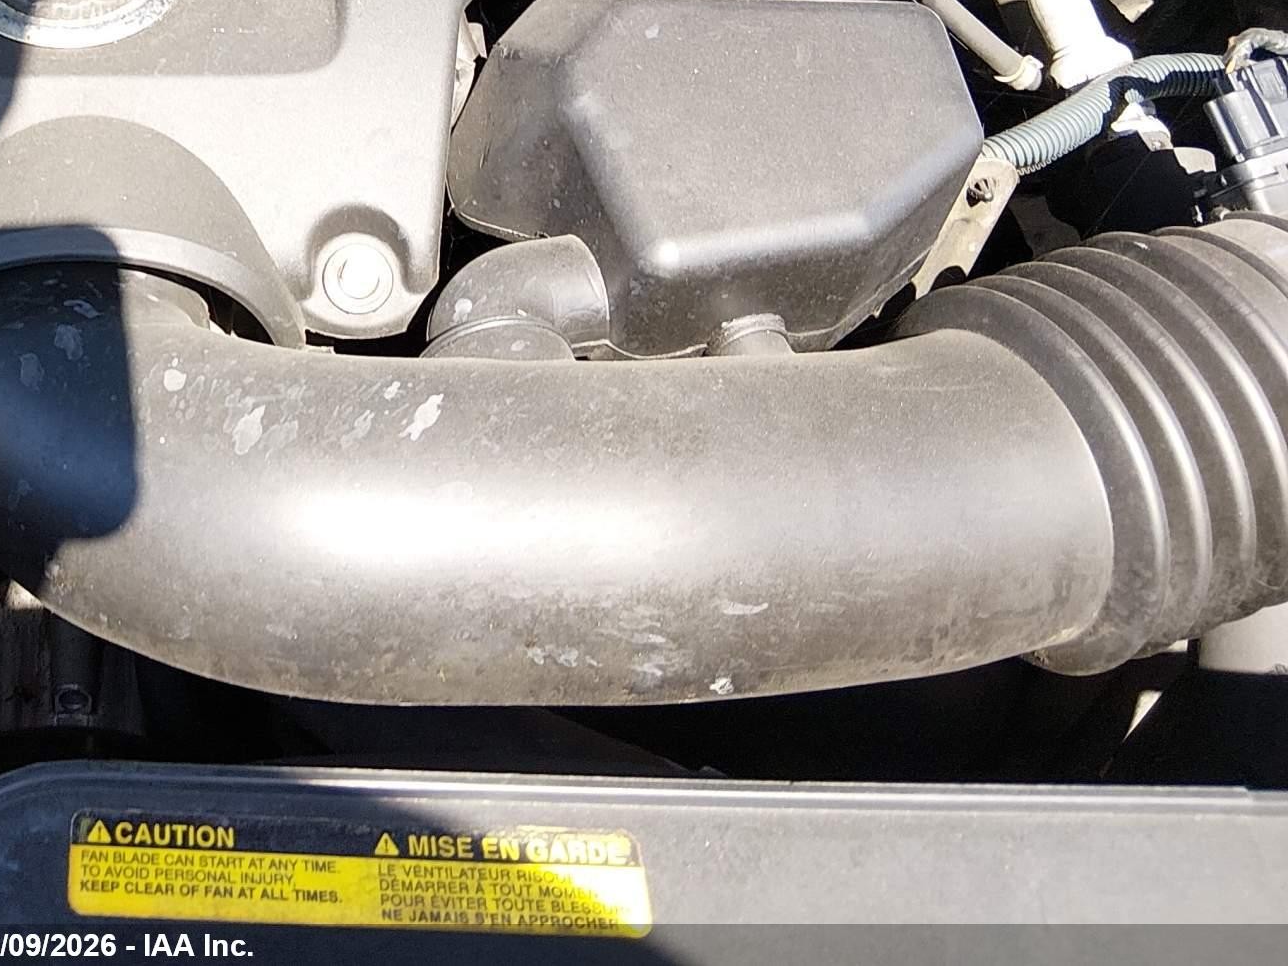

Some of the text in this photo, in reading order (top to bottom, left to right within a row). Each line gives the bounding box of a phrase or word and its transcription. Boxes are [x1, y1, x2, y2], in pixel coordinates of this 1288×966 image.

[115, 821, 234, 848] CAUTION
[408, 834, 629, 866] MISE EN GARDE
[81, 849, 341, 874] FAN BLADE CAN START AT ANY TIME.
[81, 864, 102, 878] TO
[104, 865, 150, 880] AVOID
[154, 868, 236, 884] PERSONAL
[378, 864, 399, 878] LE
[402, 865, 513, 882] VENTILATEUR
[80, 880, 343, 904] KEEP CLEAR OF FAN AT ALL TIMES.
[491, 884, 534, 898] TOUT
[380, 893, 426, 908] POUR
[494, 898, 547, 913] TOUTE
[381, 909, 404, 922] NE
[408, 910, 470, 925] JAMAIS
[474, 913, 512, 927] S'EN
